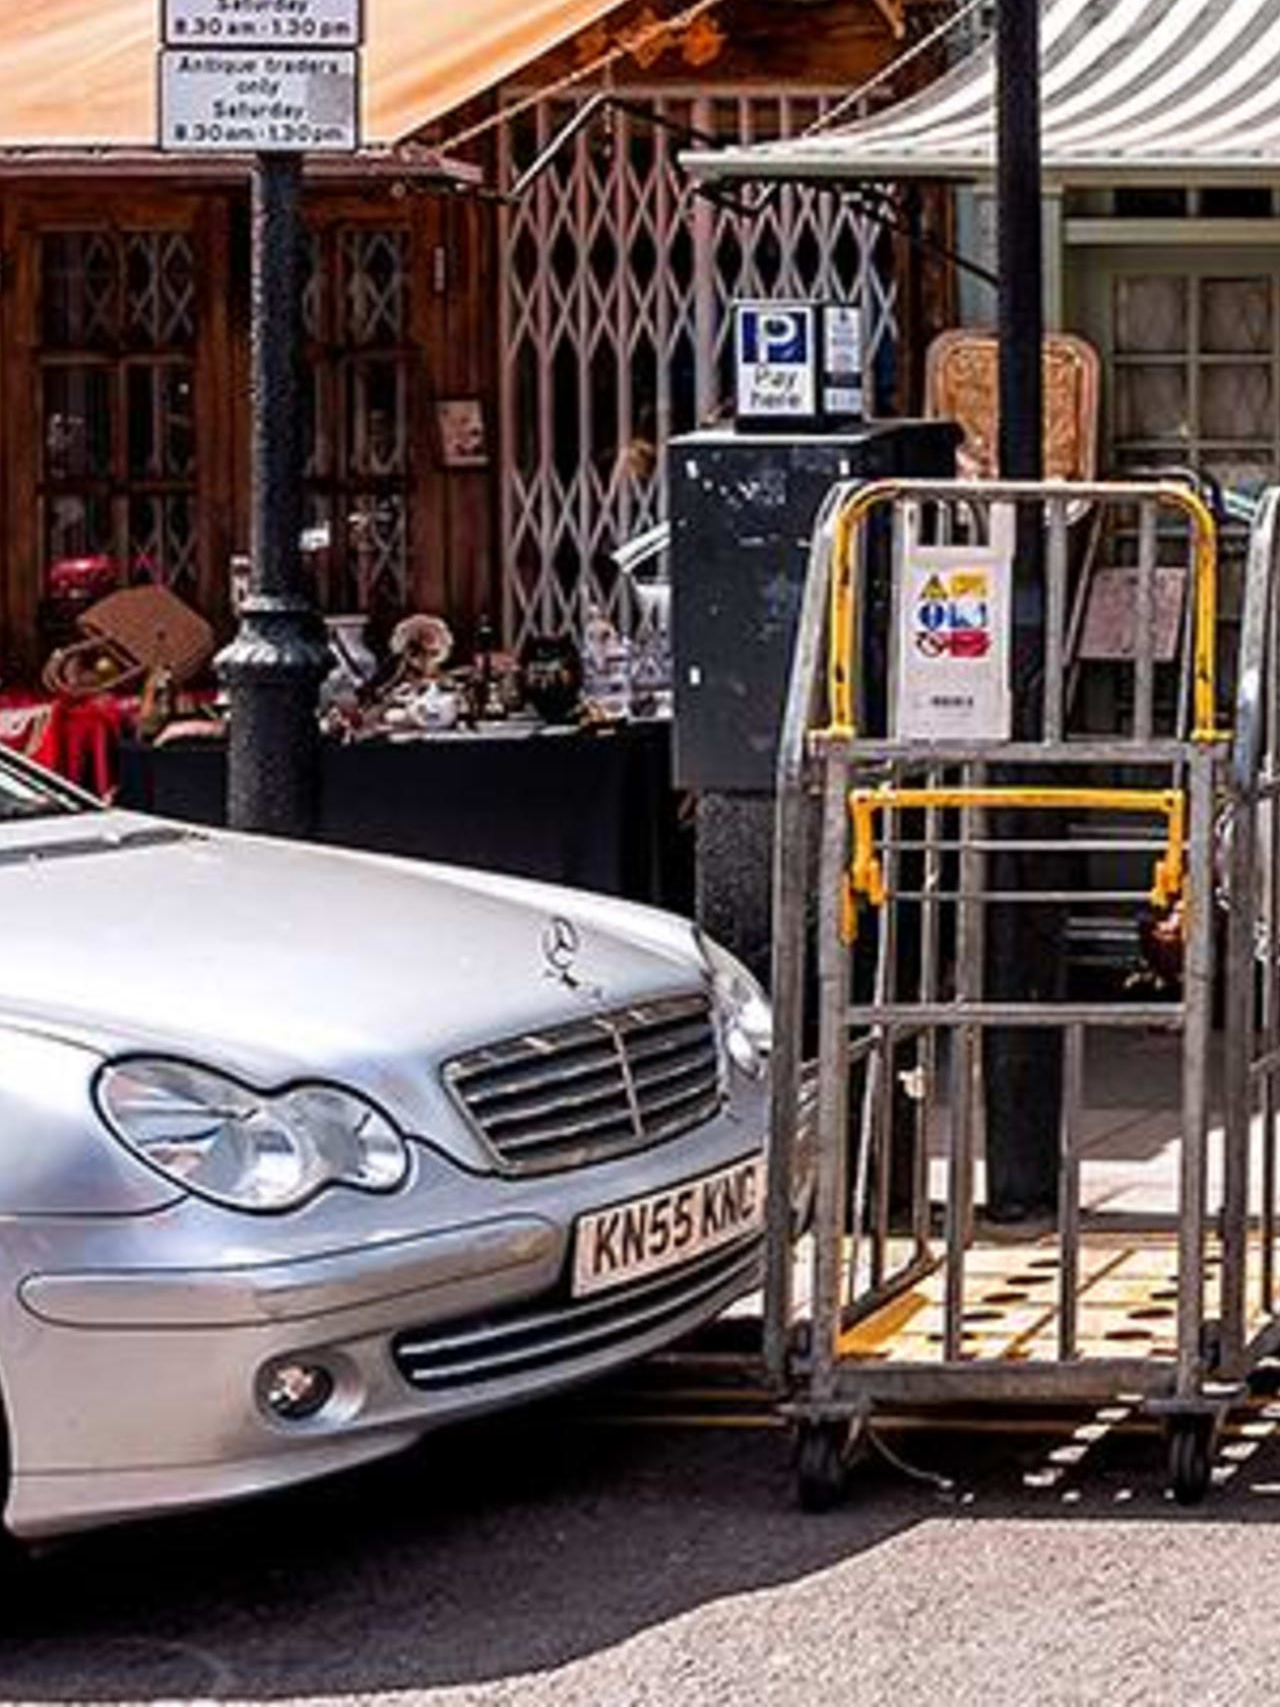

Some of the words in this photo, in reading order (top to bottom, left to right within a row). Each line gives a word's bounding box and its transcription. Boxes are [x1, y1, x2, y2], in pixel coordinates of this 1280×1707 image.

[177, 56, 257, 75] Antique
[265, 57, 339, 76] traders
[235, 77, 281, 97] only
[212, 99, 304, 121] Saturday
[757, 314, 796, 363] P
[755, 366, 799, 391] Pay
[750, 392, 801, 409] here
[592, 1190, 695, 1275] KN55
